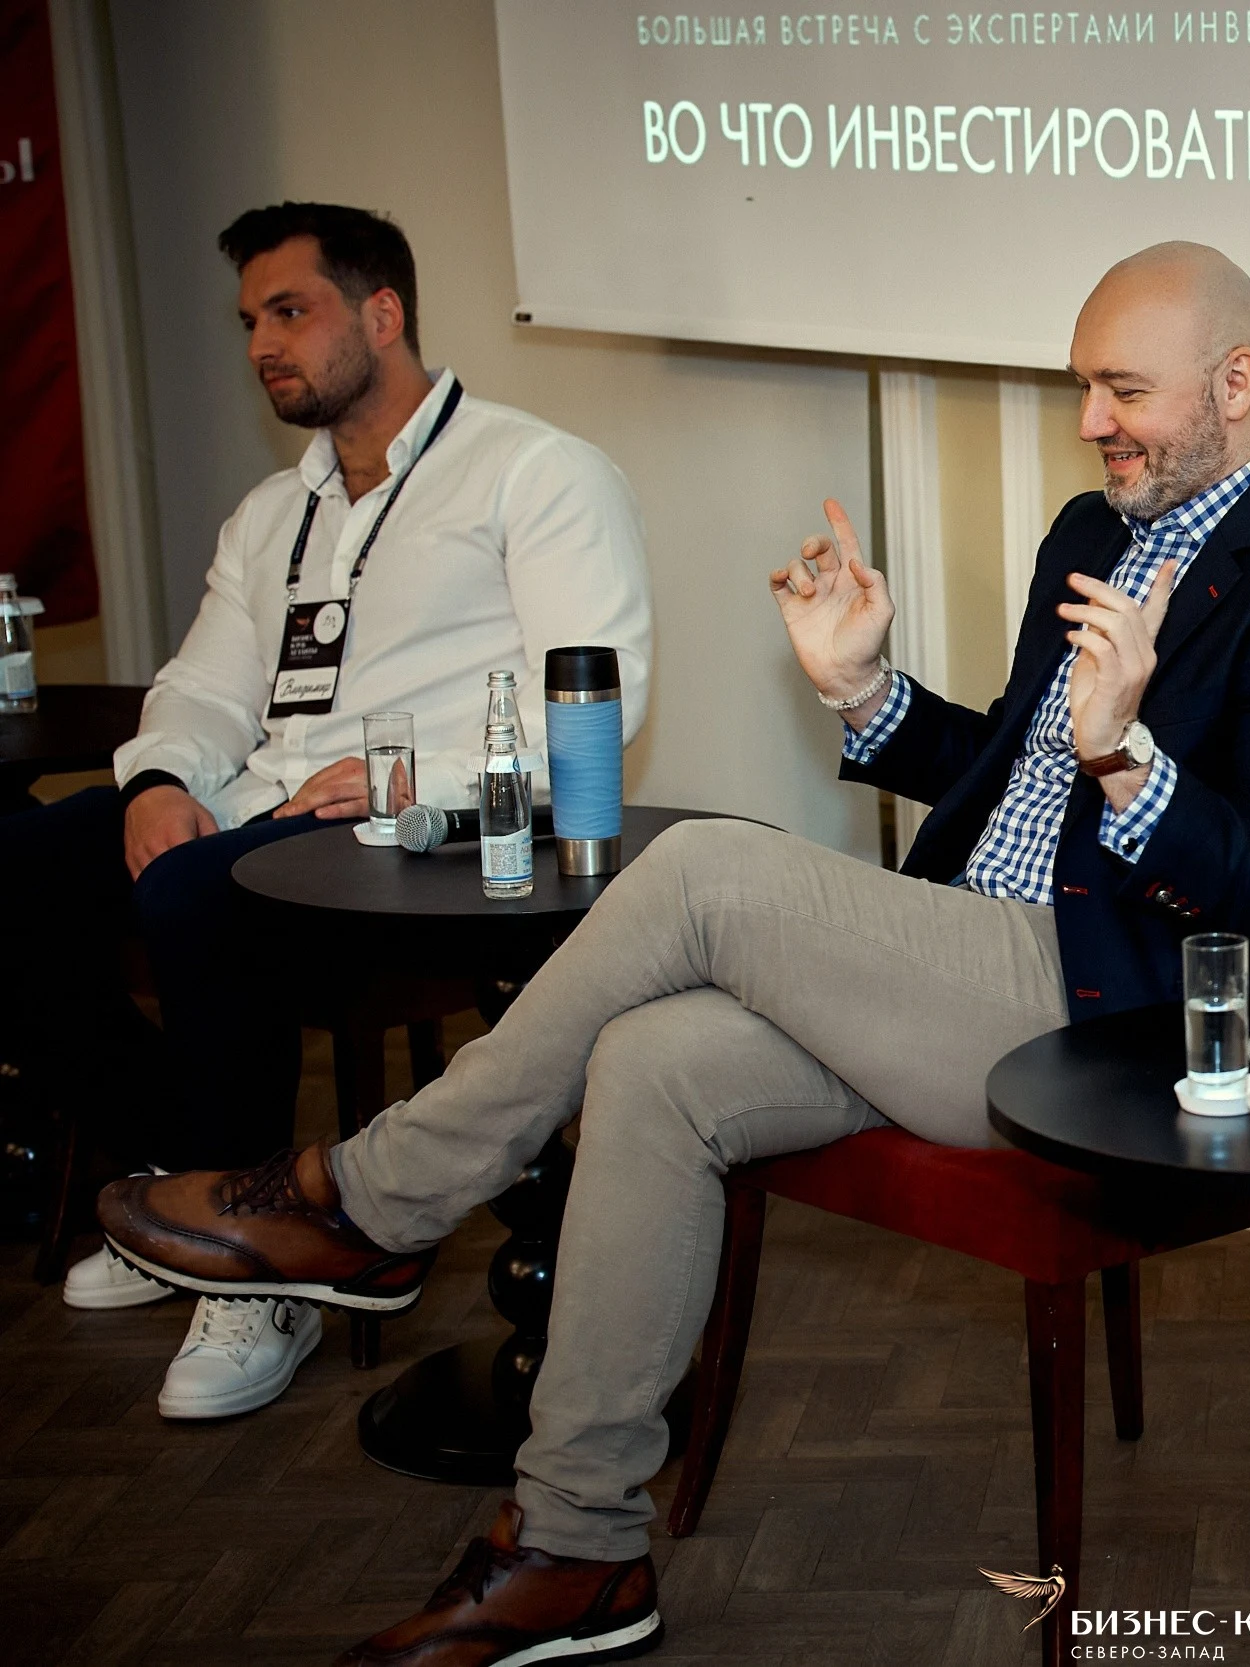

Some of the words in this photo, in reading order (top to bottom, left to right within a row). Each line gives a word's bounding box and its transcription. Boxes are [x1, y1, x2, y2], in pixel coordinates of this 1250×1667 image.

[637, 15, 767, 46] БОЛЬШАЯ
[780, 14, 900, 46] ВСТРЕЧА
[913, 13, 932, 46] С
[947, 12, 1155, 46] ЭКСПЕРТАМИ
[643, 100, 707, 165] ВО
[719, 102, 813, 168] ЧТО
